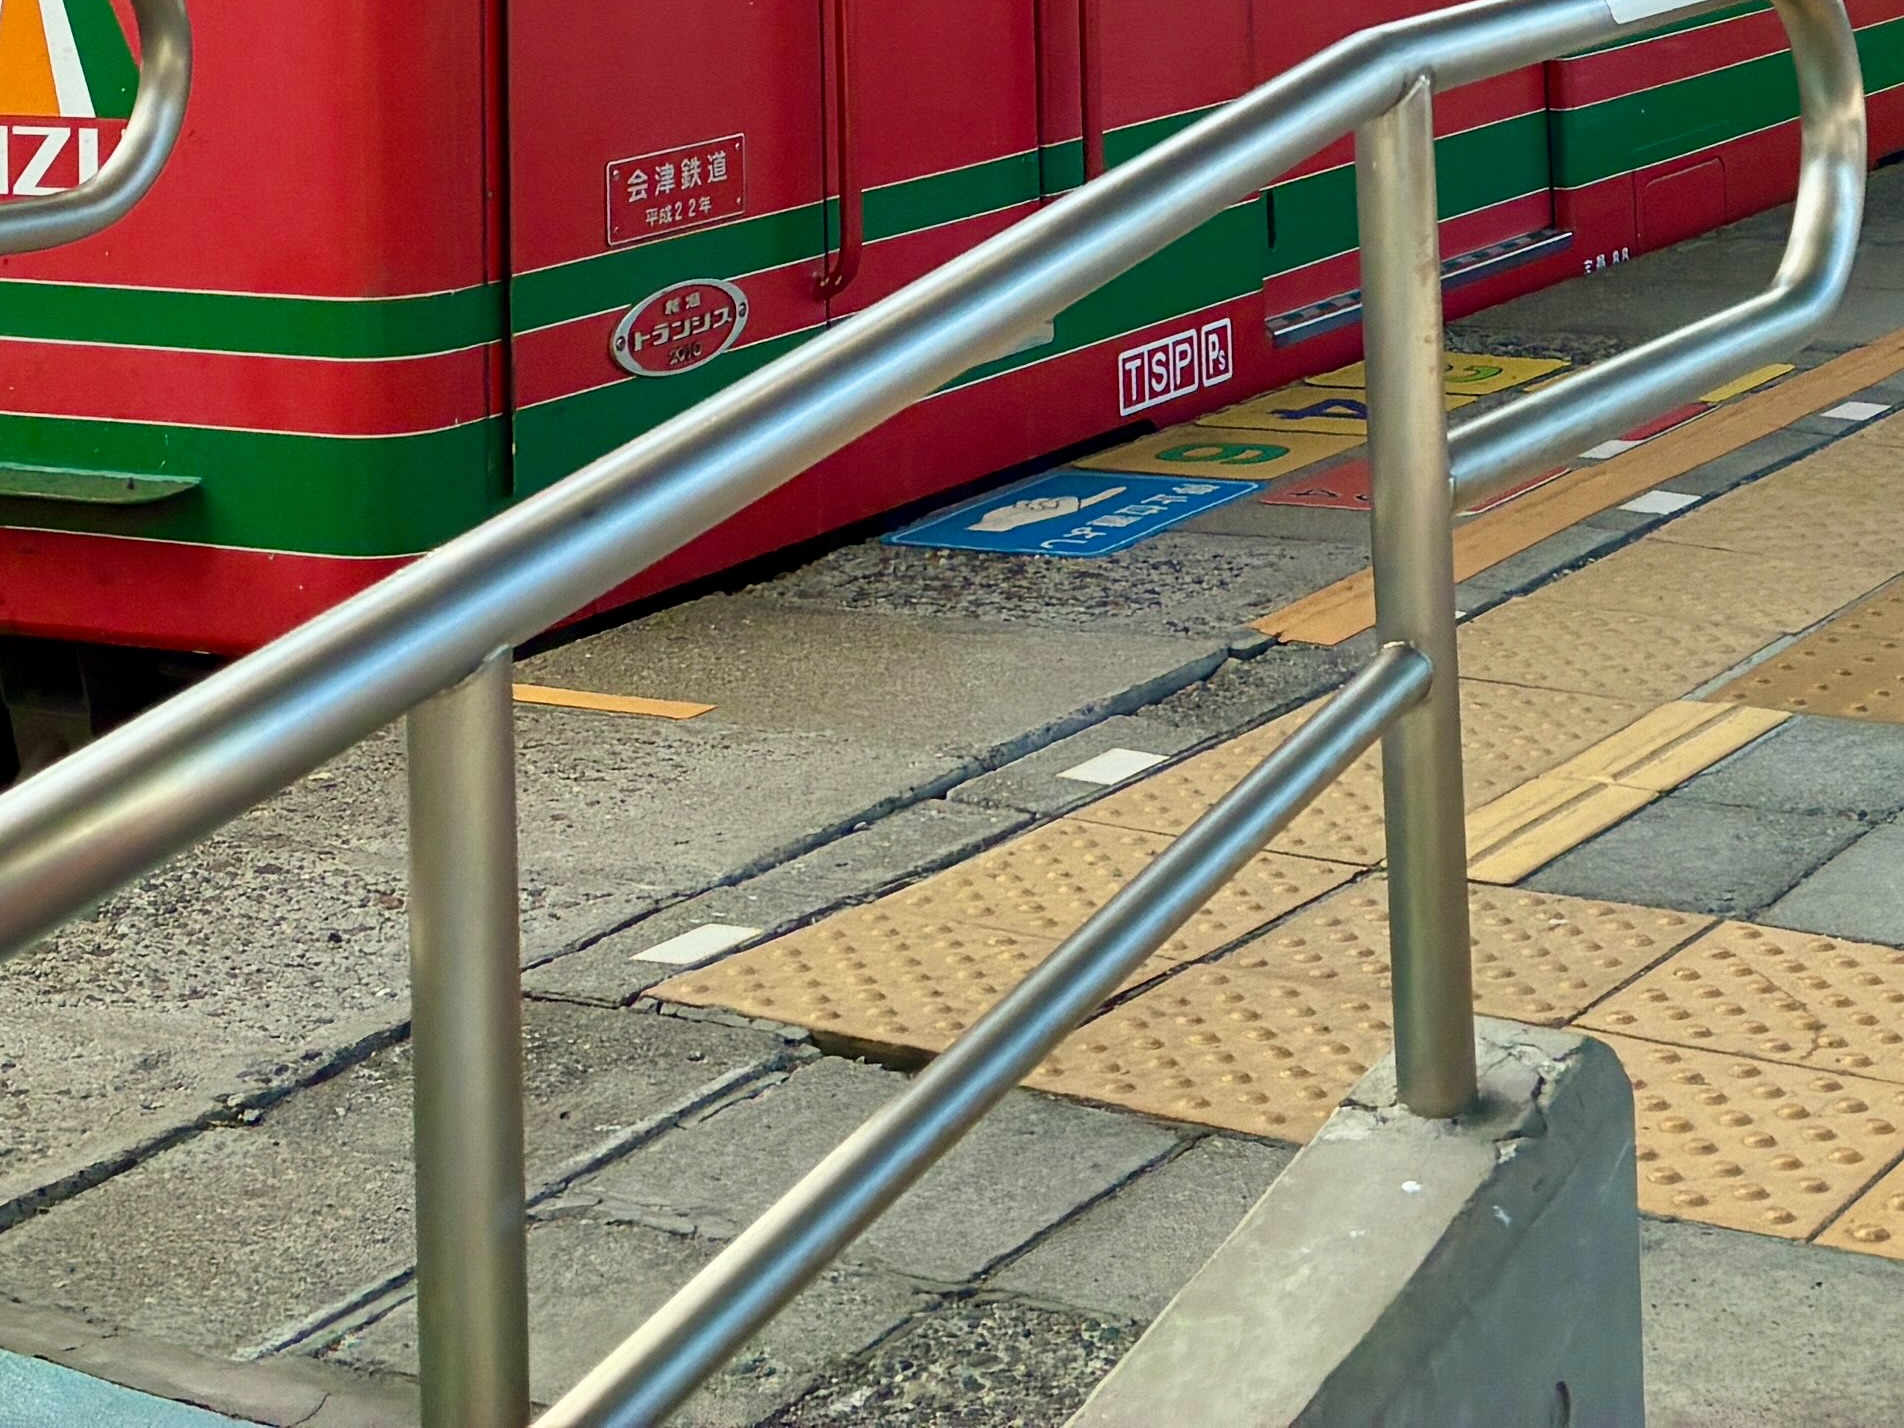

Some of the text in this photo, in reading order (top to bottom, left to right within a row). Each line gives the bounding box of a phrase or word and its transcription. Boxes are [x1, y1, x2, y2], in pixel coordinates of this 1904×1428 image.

[627, 150, 729, 203] 会津鉄道
[646, 196, 712, 226] 平成22年
[633, 306, 733, 352] トランシス
[1125, 342, 1192, 392] TSP
